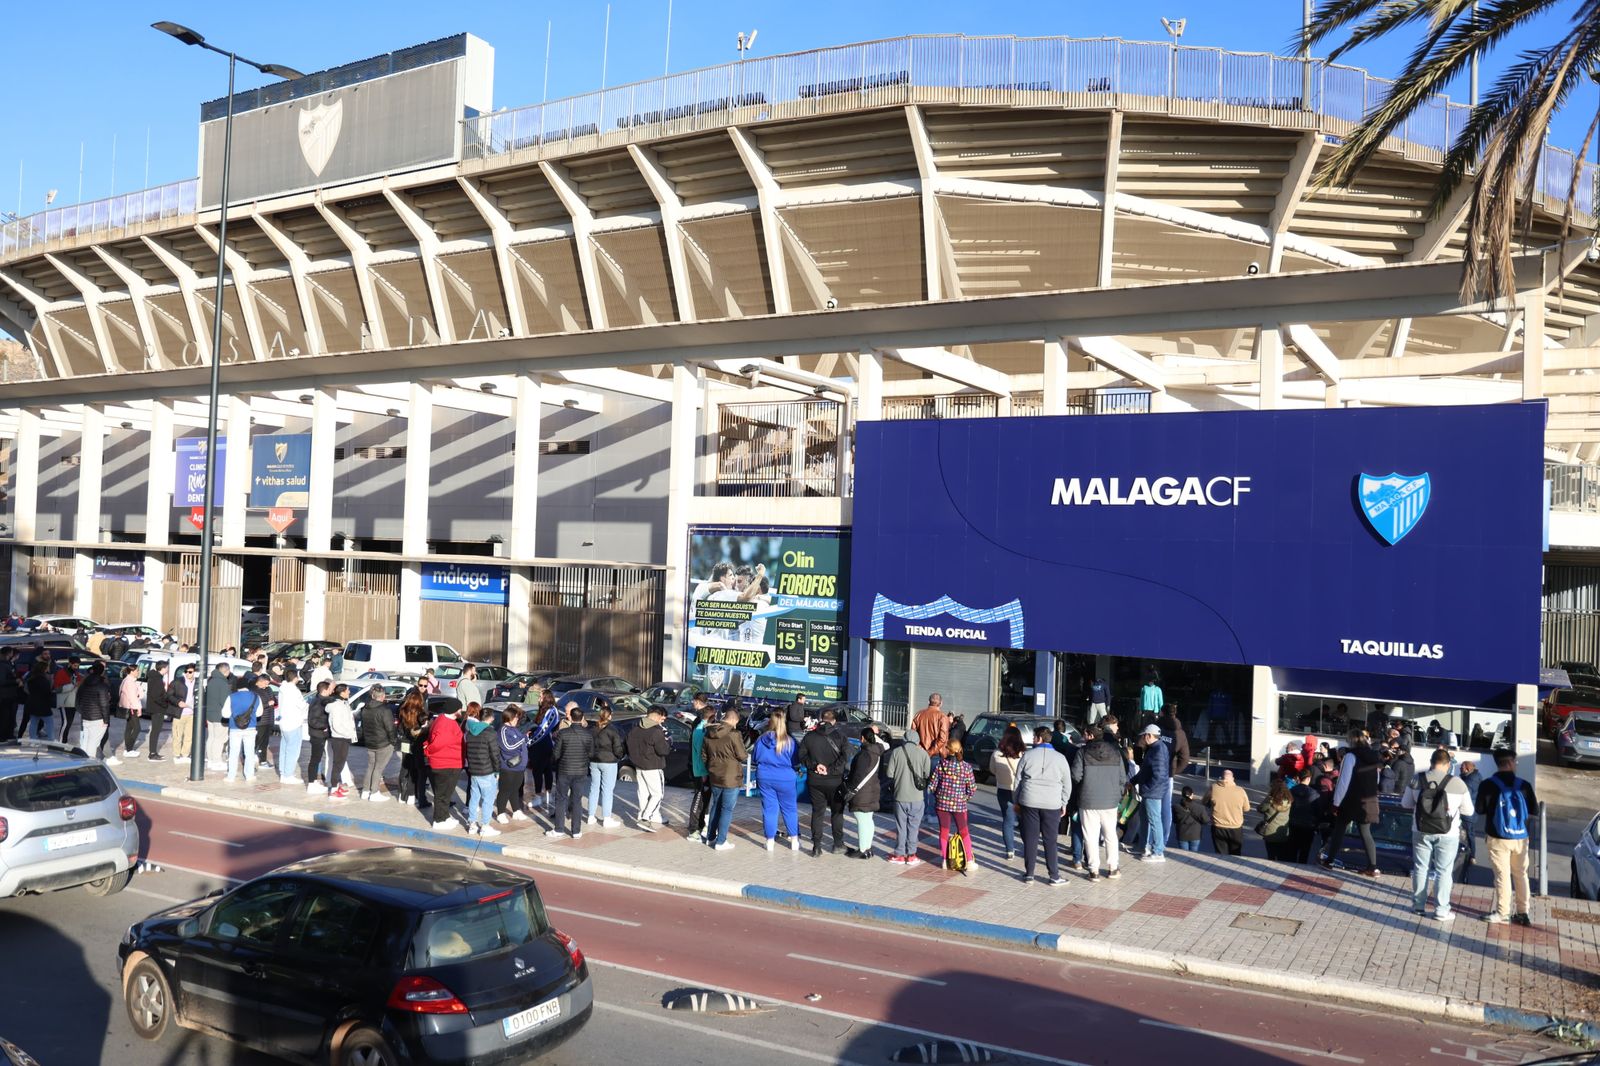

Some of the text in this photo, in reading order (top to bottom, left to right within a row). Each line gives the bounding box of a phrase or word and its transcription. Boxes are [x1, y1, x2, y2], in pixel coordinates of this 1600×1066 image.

[262, 475, 306, 486] vithas salud
[188, 494, 204, 502] DENT
[783, 550, 815, 568] Olin
[433, 564, 489, 590] málaga
[779, 573, 837, 597] FOROFOS
[780, 598, 795, 607] DEL
[796, 598, 829, 609] MÁLAGA
[777, 632, 796, 650] 15
[904, 625, 987, 640] TIENDA OFICIAL
[810, 634, 830, 653] 19
[1340, 639, 1444, 660] TAQUILLAS
[696, 647, 764, 667] ¡VA POR USTEDES!
[512, 1000, 558, 1030] 0100 FNB
